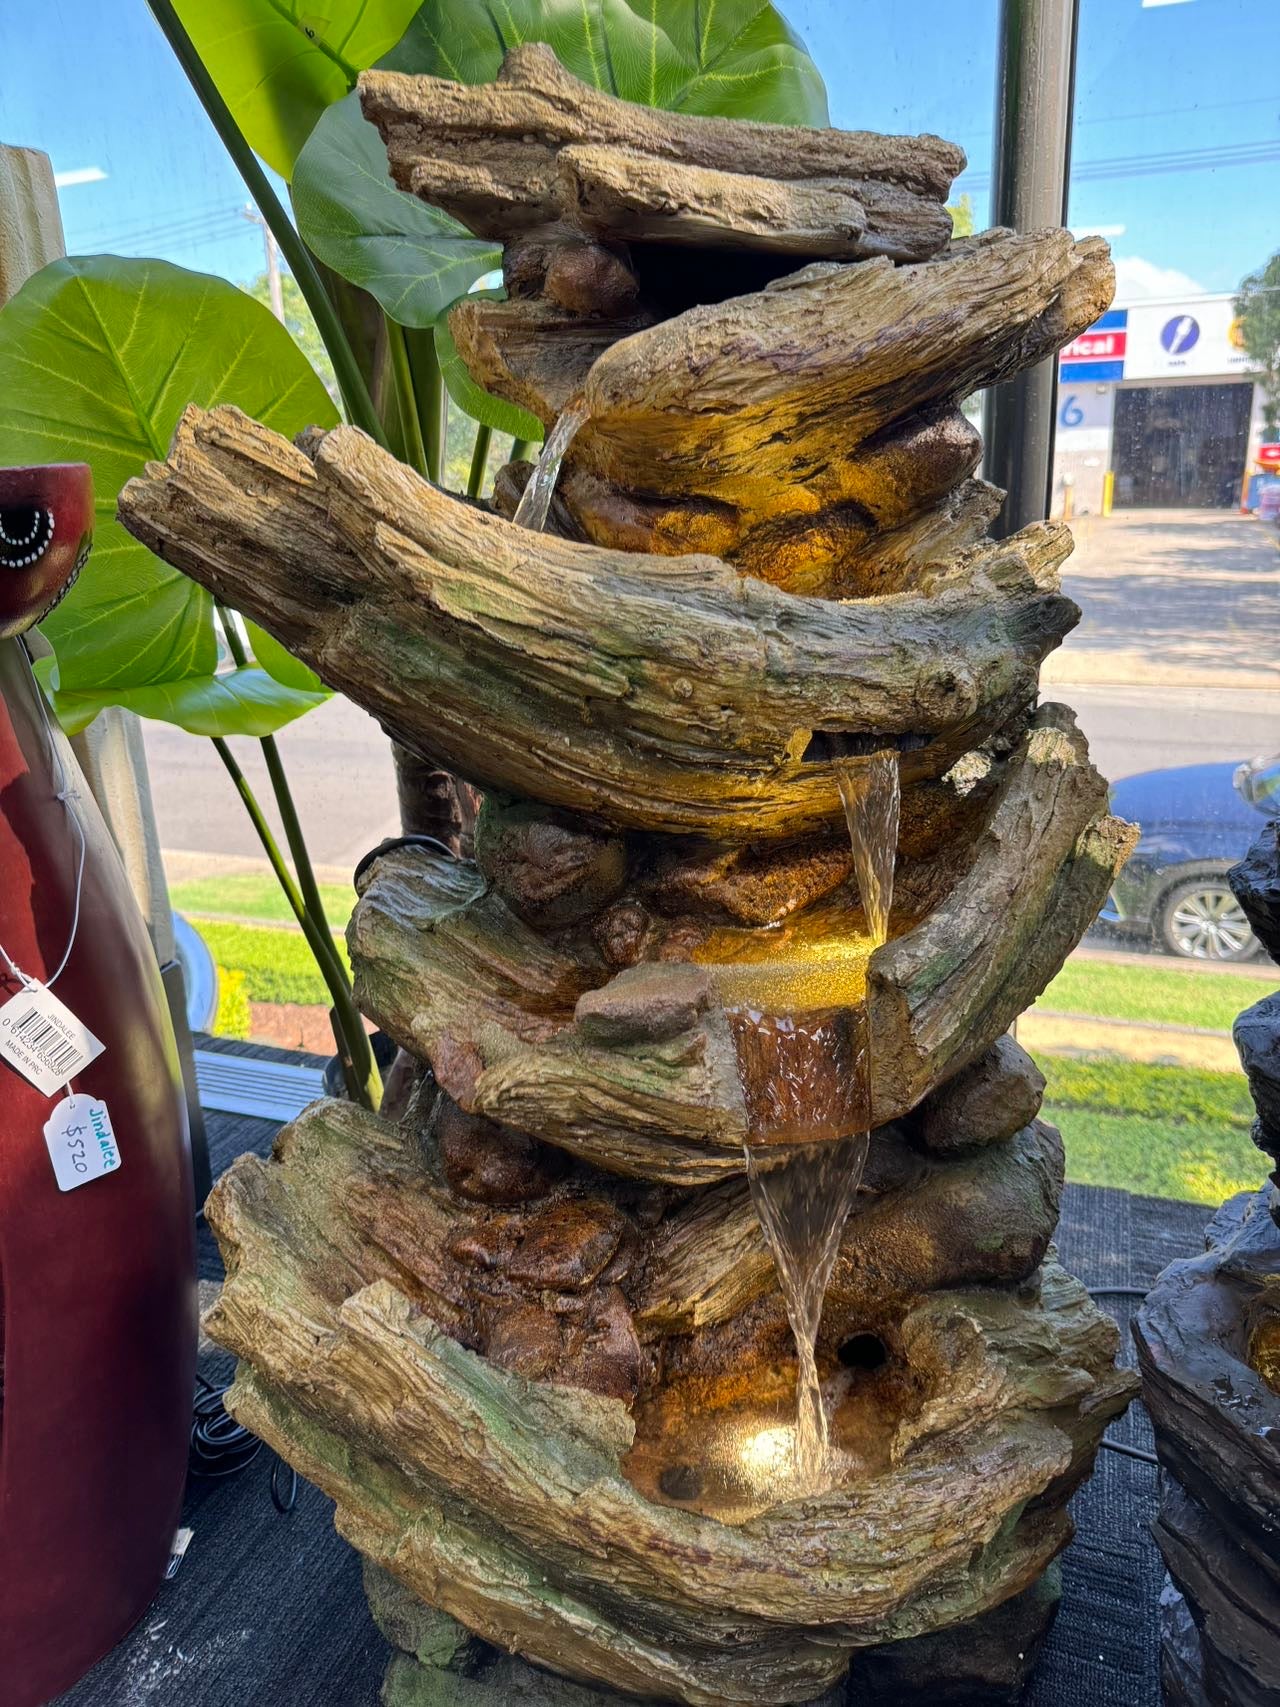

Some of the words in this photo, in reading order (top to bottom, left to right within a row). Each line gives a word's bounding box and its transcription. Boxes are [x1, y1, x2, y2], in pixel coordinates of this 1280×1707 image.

[1060, 396, 1084, 427] 6
[47, 1014, 76, 1040] JINDALEE
[5, 1040, 24, 1058] MADE
[22, 1056, 30, 1065] IN
[28, 1060, 43, 1075] PRC
[61, 1125, 88, 1173] $520
[89, 1108, 116, 1169] Jindalee
